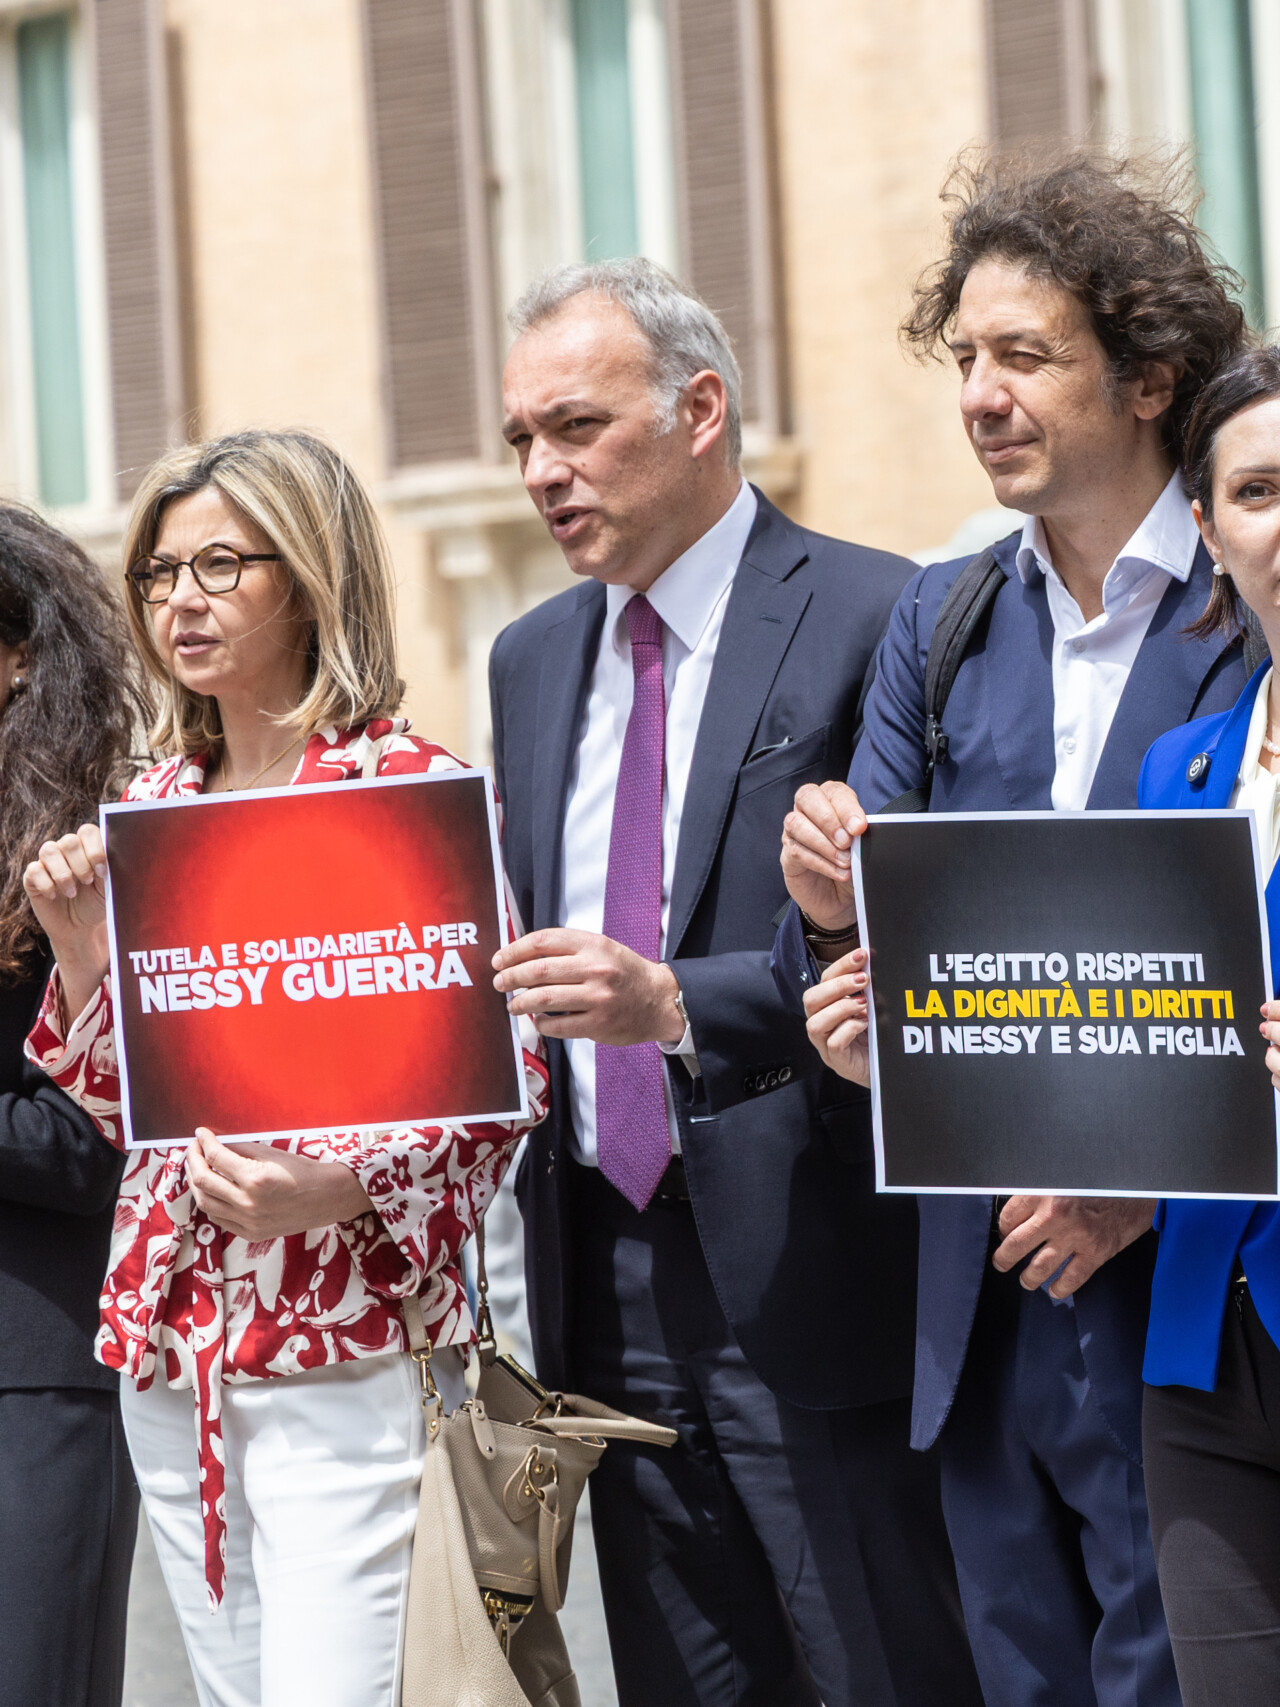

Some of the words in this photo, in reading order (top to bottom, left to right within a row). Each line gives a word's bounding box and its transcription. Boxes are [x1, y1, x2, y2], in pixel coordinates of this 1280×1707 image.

[128, 945, 217, 974] TUTELA
[221, 943, 239, 967] E
[244, 922, 417, 965] SOLIDARIETÀ
[422, 922, 478, 949] PER
[929, 952, 1069, 982] L’EGITTO
[1076, 953, 1205, 982] RISPETTI
[139, 966, 269, 1014] NESSY
[282, 950, 473, 1001] GUERRA
[905, 989, 947, 1019] LA
[954, 981, 1082, 1019] DIGNITÀ
[1089, 989, 1108, 1018] E
[1115, 989, 1124, 1018] I
[1132, 989, 1235, 1019] DIRITTI
[902, 1025, 933, 1054] DI
[941, 1025, 1043, 1055] NESSY
[1051, 1025, 1072, 1055] E
[1078, 1025, 1142, 1055] SUA
[1148, 1026, 1245, 1056] FIGLIA
